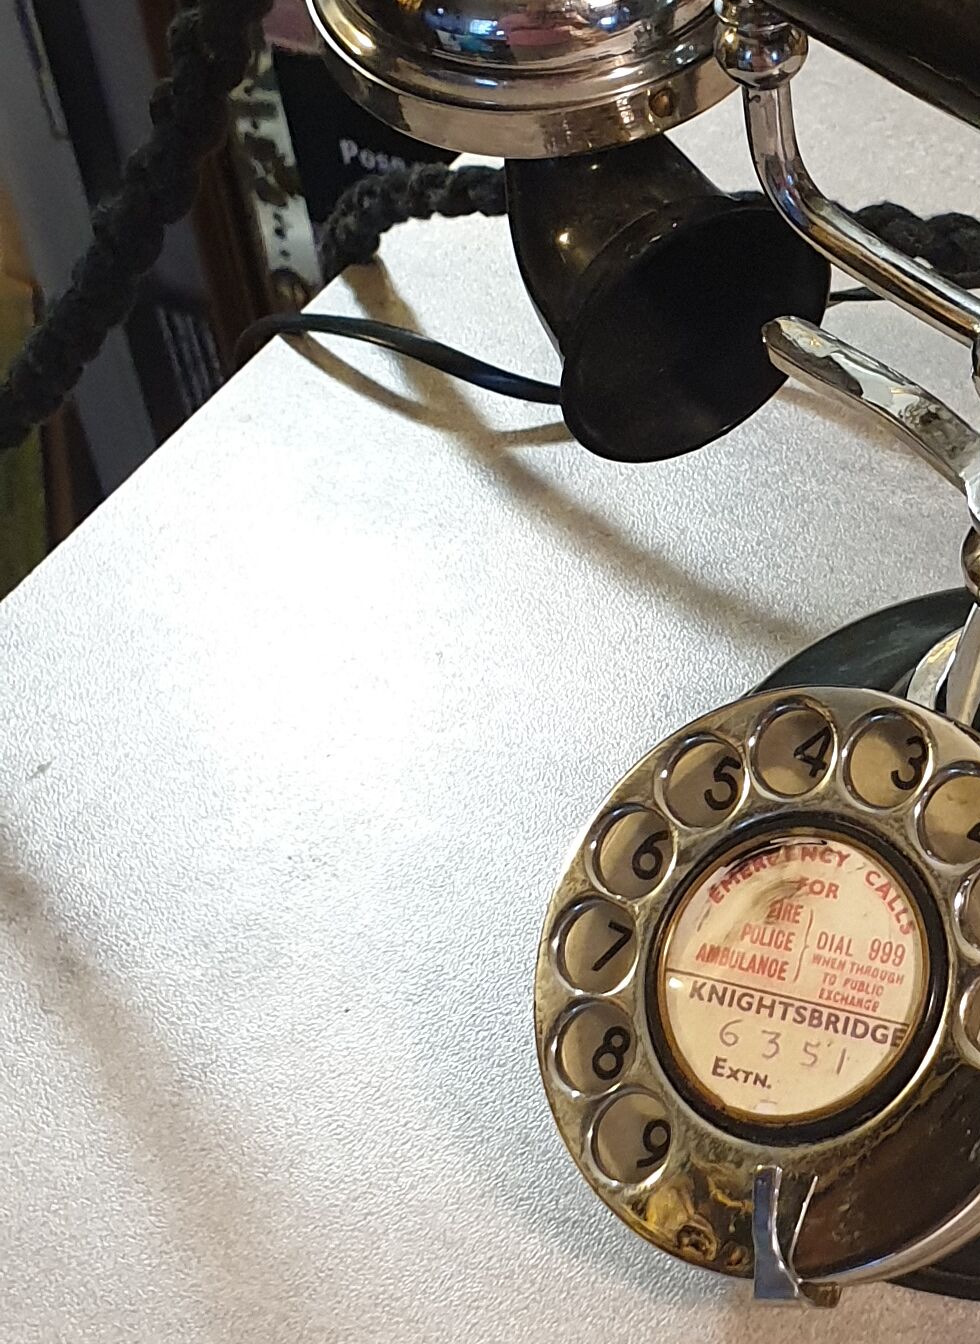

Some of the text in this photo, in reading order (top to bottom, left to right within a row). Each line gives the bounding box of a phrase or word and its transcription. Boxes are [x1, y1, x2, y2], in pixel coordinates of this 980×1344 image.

[793, 726, 832, 778] 4
[891, 736, 928, 791] 3
[704, 756, 741, 811] 5
[632, 830, 669, 880] 6
[798, 875, 840, 900] FOR
[864, 870, 914, 935] CALLS
[591, 919, 633, 972] 7
[696, 942, 790, 981] AMBULANCE
[740, 922, 796, 952] POLICE
[816, 931, 906, 967] DIAL 999
[812, 953, 905, 985] WHEN THROUGH
[822, 972, 885, 997] TO PUBLIC
[689, 979, 909, 1048] KNIGHTSBRIDGE
[818, 987, 880, 1013] EXCHANGE
[592, 1026, 630, 1080] 8
[636, 1119, 671, 1168] 9
